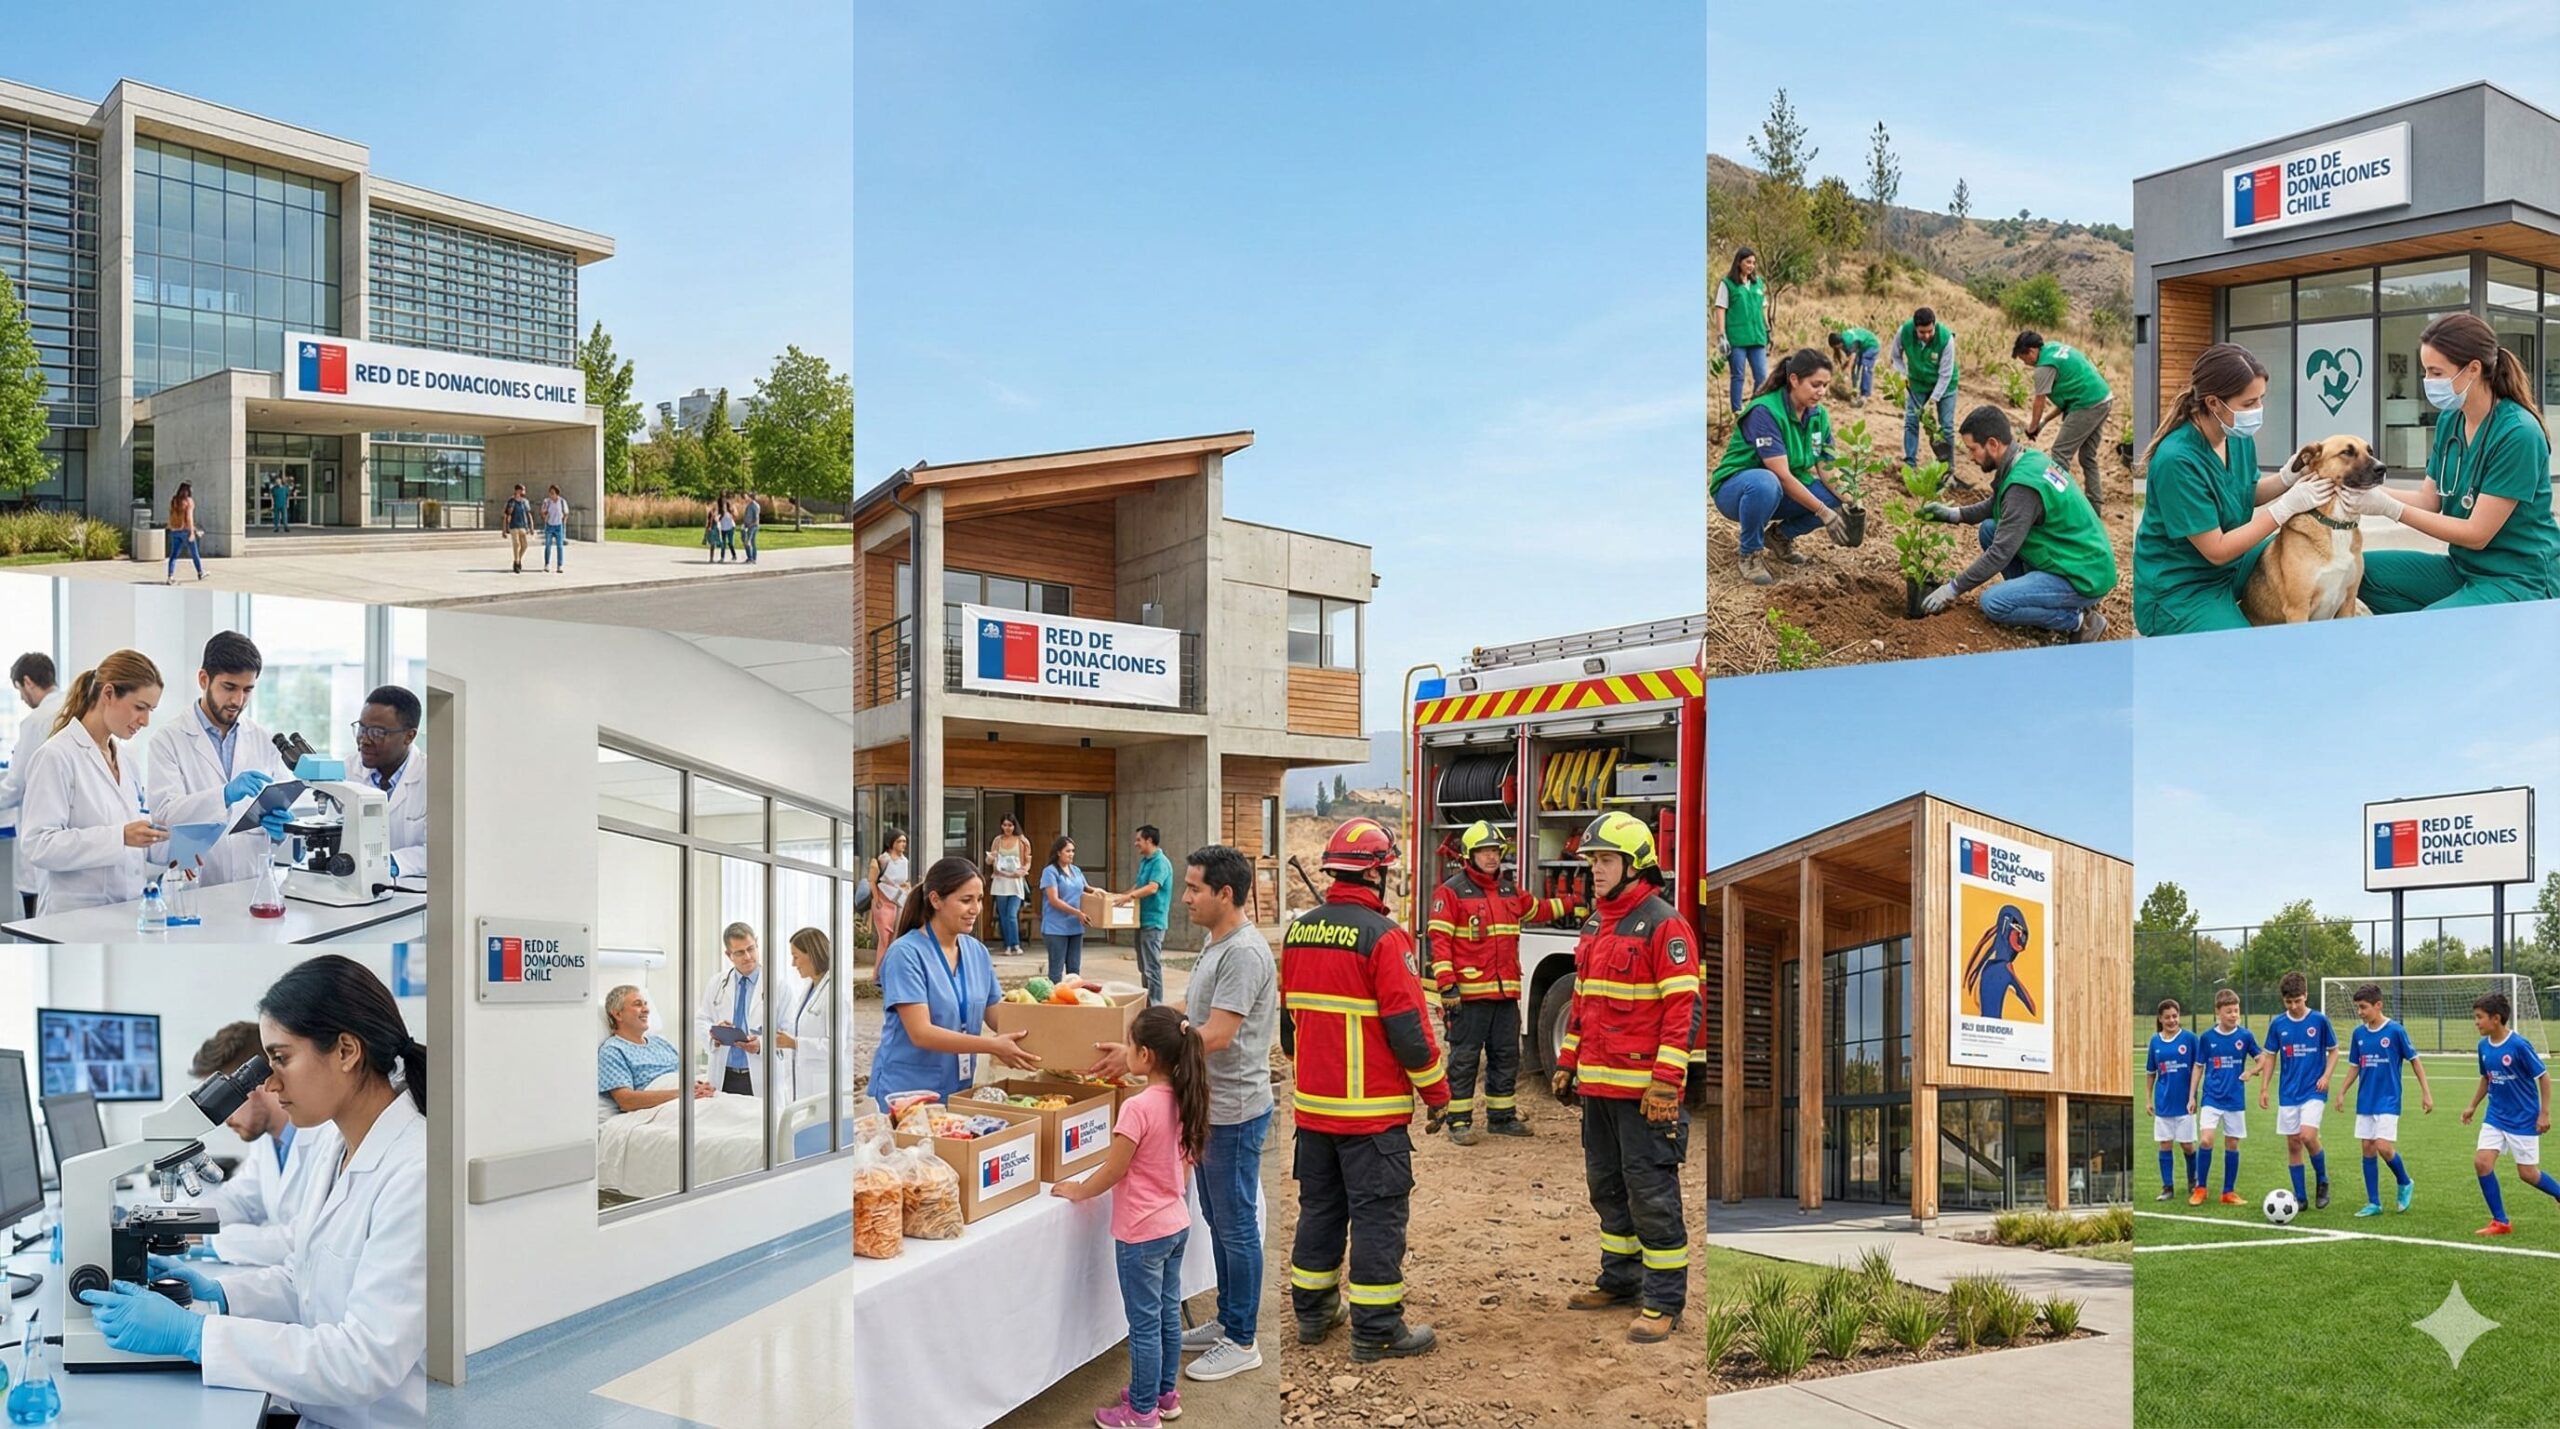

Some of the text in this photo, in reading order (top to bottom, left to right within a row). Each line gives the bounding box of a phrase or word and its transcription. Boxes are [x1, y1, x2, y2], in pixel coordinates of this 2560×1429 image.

[2287, 158, 2316, 179] RED
[2321, 150, 2342, 169] DE
[2287, 158, 2391, 197] DONACIONES
[2287, 192, 2331, 215] CHILE
[355, 363, 577, 404] RED DE DONACIONES CHILE
[1045, 627, 1084, 647] RED
[1089, 632, 1113, 650] DE
[1045, 648, 1166, 675] DONACIONES
[1045, 668, 1100, 688] CHILE
[2422, 818, 2450, 833] RED
[2454, 815, 2473, 830] DE
[2422, 828, 2517, 849] DONACIONES
[2422, 850, 2463, 866] CHILE
[1286, 919, 1359, 947] Bomberos
[546, 940, 559, 953] DE
[524, 968, 552, 981] CHILE
